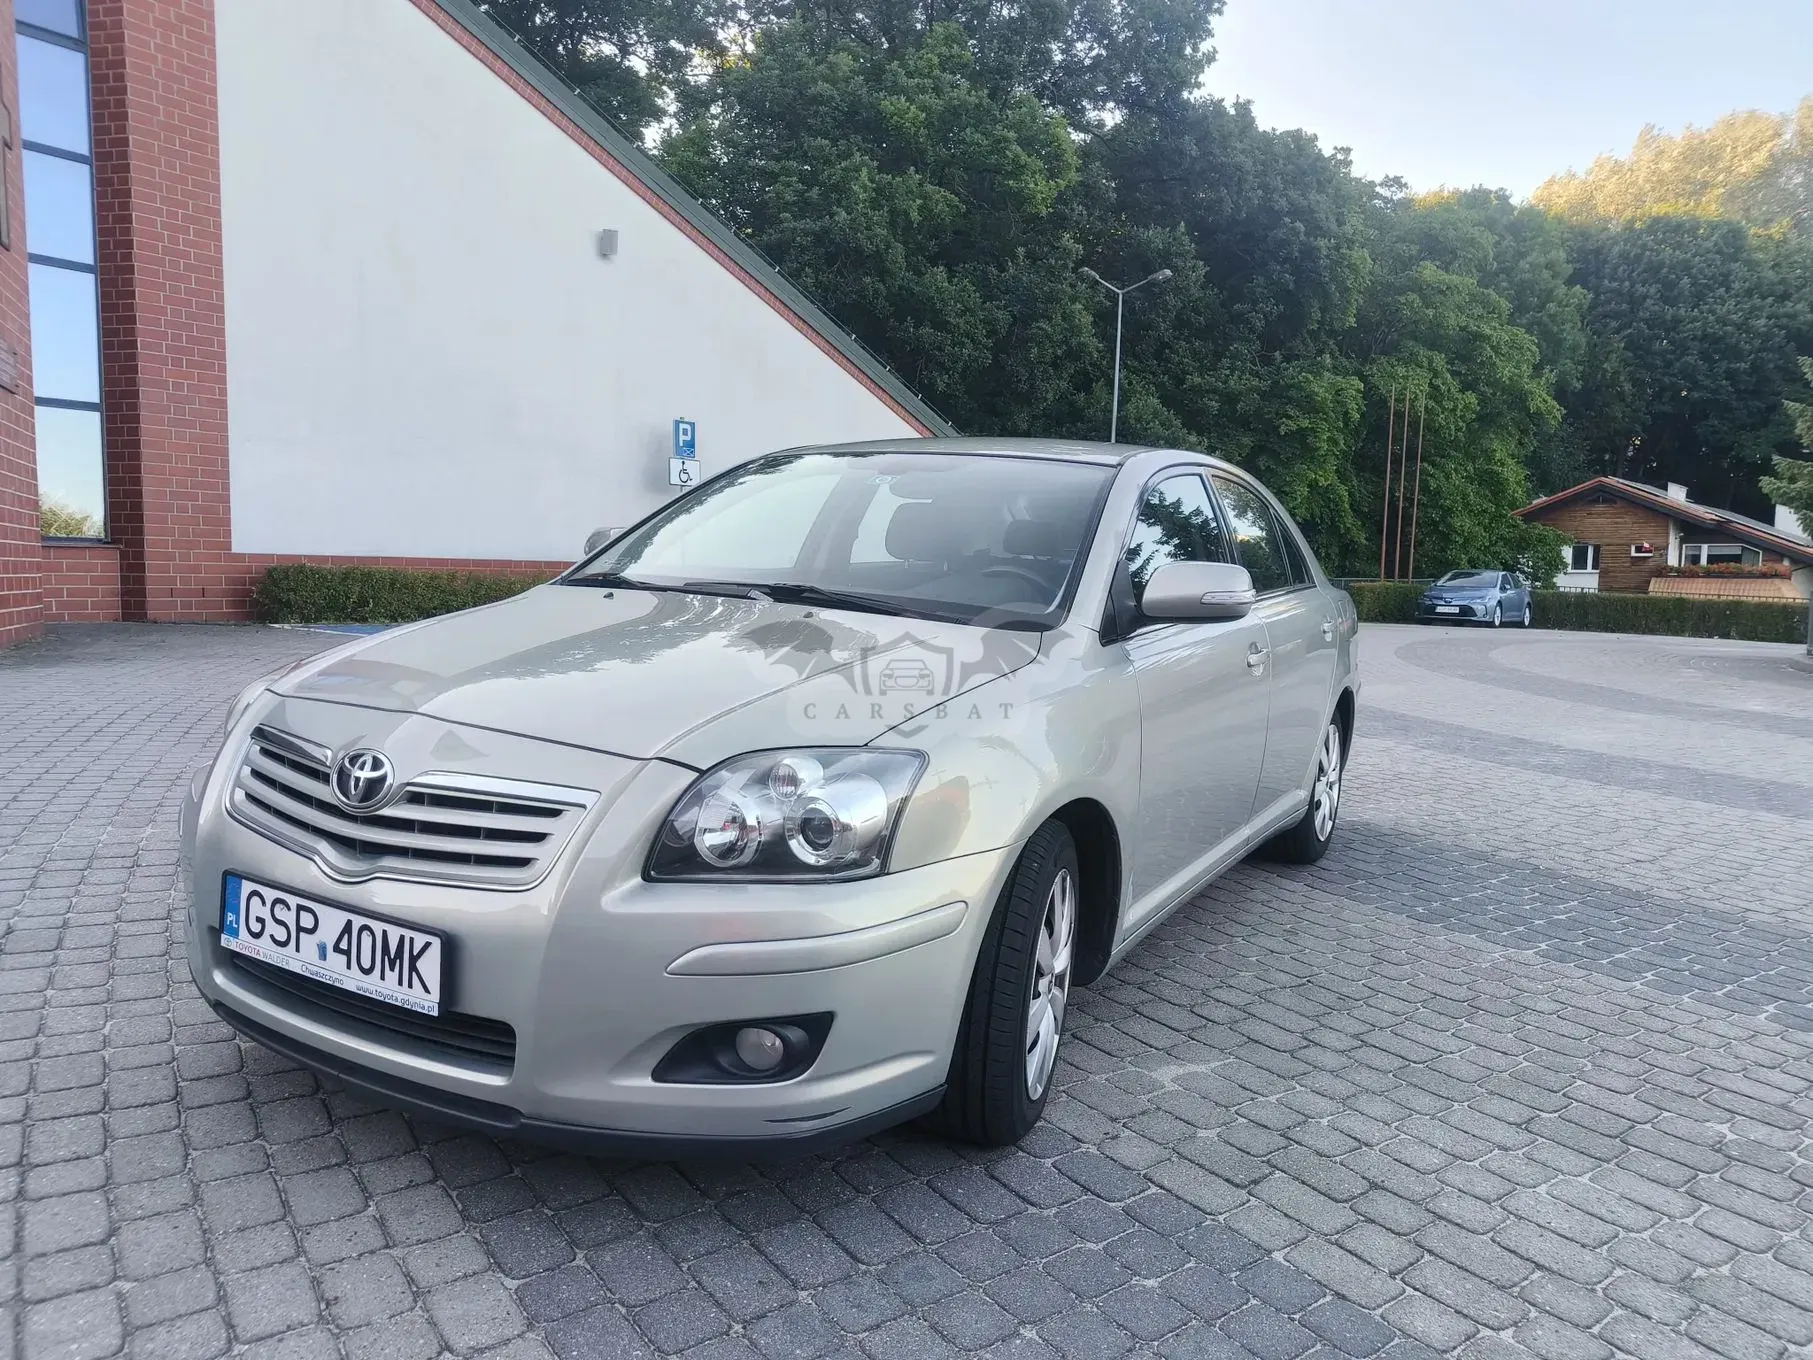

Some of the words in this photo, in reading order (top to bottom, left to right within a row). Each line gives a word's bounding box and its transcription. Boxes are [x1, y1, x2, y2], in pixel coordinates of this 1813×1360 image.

[679, 423, 691, 446] P
[226, 912, 238, 928] PL
[244, 889, 320, 953] GSP
[332, 918, 433, 995] 40MK
[234, 942, 261, 957] TOYOTA
[262, 952, 289, 968] WALDER
[300, 964, 345, 986] Chwaszczyno
[355, 984, 435, 1013] www.toyota.gdynia.pl
